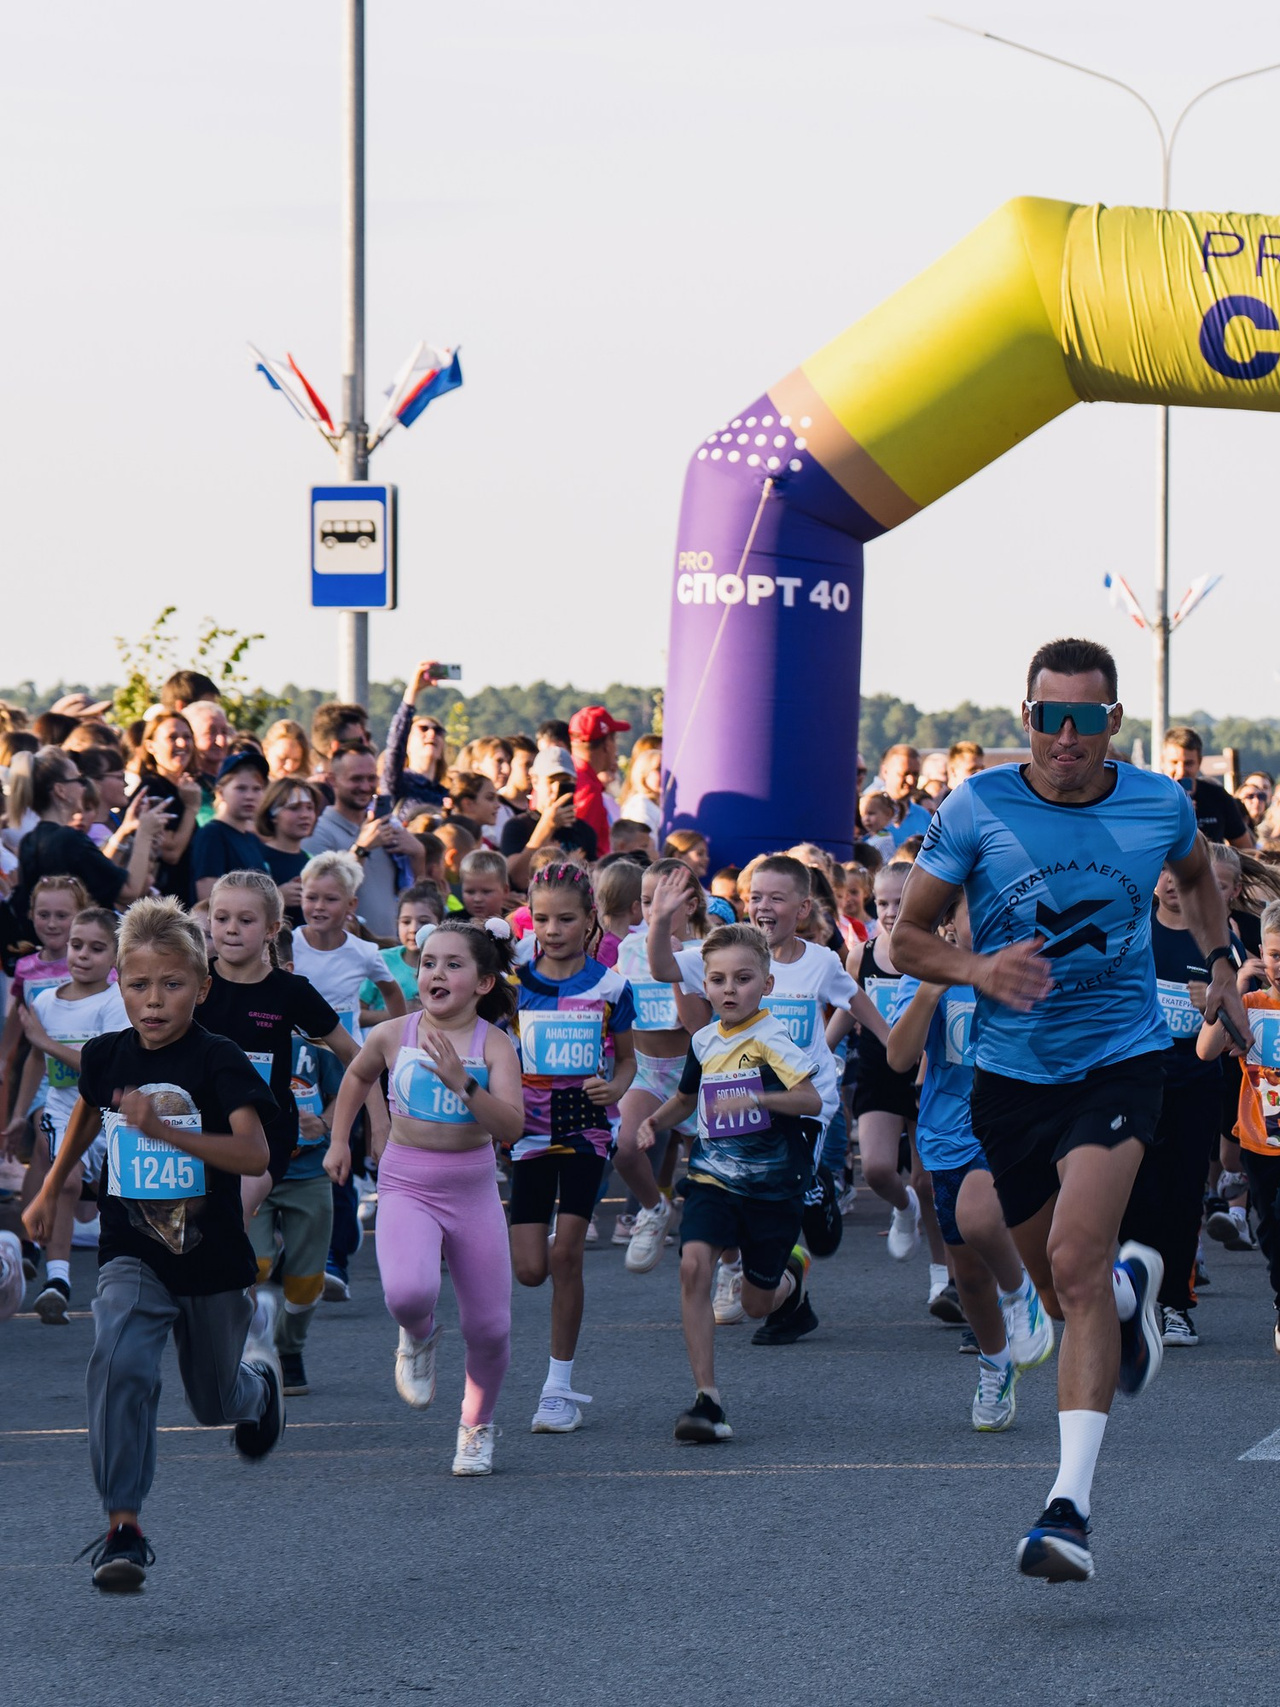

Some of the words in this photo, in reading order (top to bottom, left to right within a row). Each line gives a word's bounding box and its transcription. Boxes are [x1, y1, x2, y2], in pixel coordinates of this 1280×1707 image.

[678, 551, 714, 572] PRO
[676, 572, 803, 608] СПОРТ
[808, 579, 851, 613] 40
[1004, 860, 1079, 916] КОМАНДА
[1084, 861, 1142, 917] ЛЕГКОВА
[1073, 935, 1133, 993] ЛЕГКОВА
[1161, 996, 1195, 1009] ЕКАТЕРИ
[255, 1020, 273, 1028] VERA
[545, 1027, 595, 1040] АНАСТАСИЯ
[544, 1041, 595, 1069] 4496
[54, 1059, 80, 1081] 34
[131, 1155, 195, 1190] 1245
